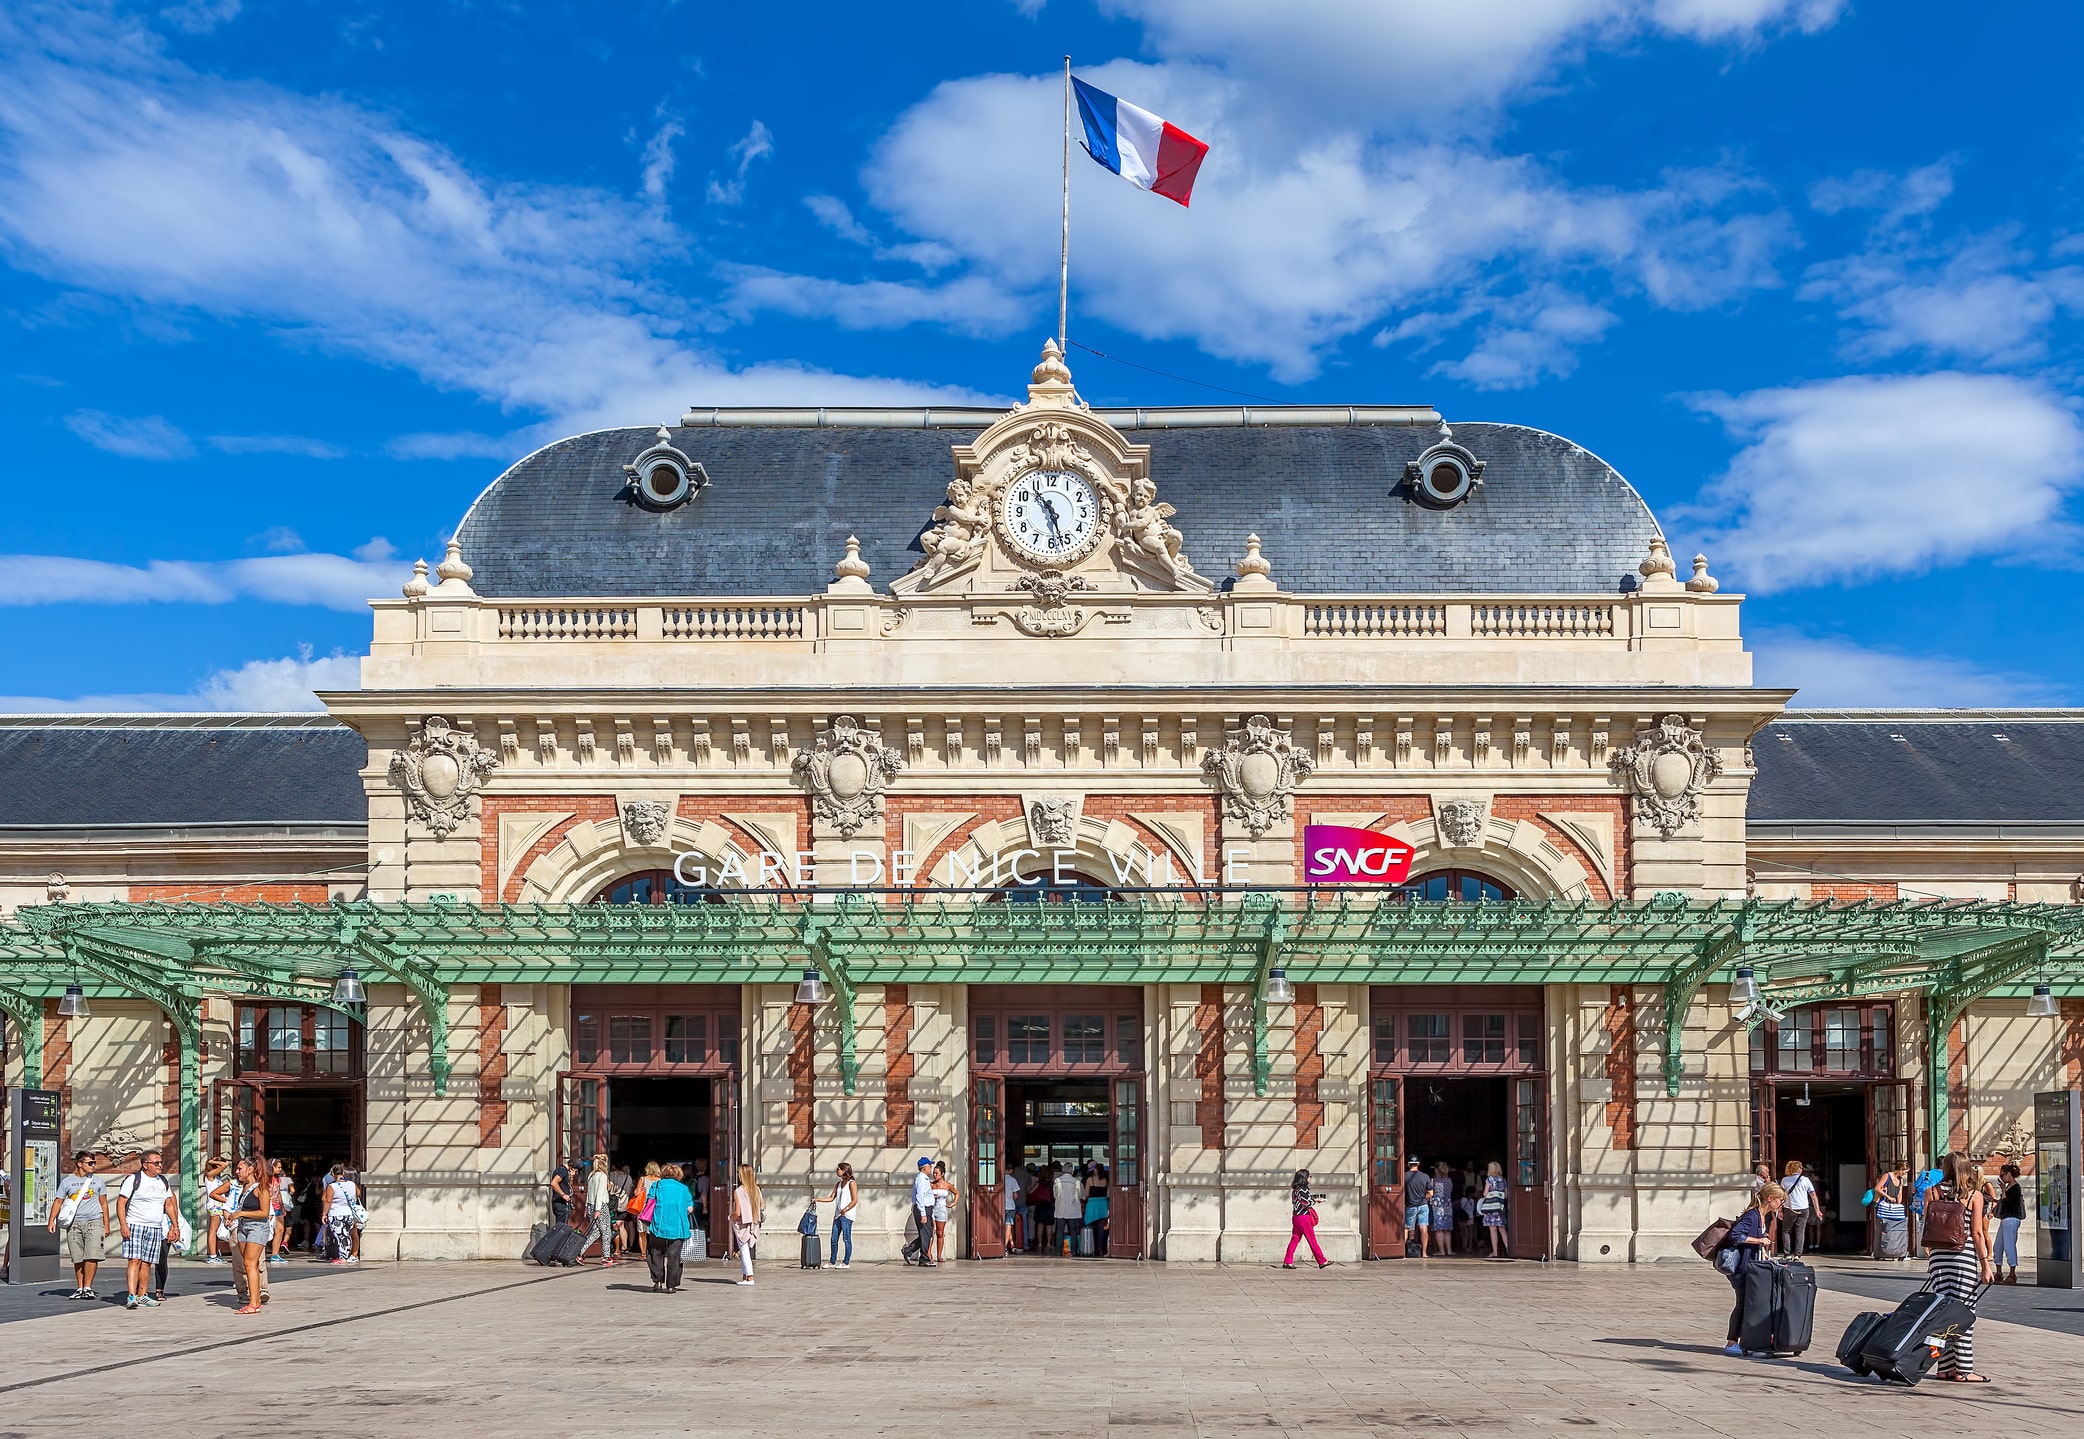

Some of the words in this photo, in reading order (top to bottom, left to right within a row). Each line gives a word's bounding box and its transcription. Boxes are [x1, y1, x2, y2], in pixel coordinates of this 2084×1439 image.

[1032, 480, 1040, 490] 11
[1047, 475, 1057, 487] 12
[1018, 490, 1029, 502] 10
[1075, 491, 1083, 502] 2
[1015, 506, 1023, 517] 9
[1080, 507, 1087, 518] 3
[1020, 522, 1027, 533] 8
[1075, 522, 1083, 533] 4
[1032, 533, 1039, 545] 7
[1047, 537, 1055, 549] 6
[1064, 533, 1071, 545] 5
[673, 850, 820, 887] GARE
[851, 850, 916, 885] DE
[948, 849, 1078, 885] NICE
[1106, 849, 1252, 884] VILLE
[1309, 847, 1408, 877] SNCF
